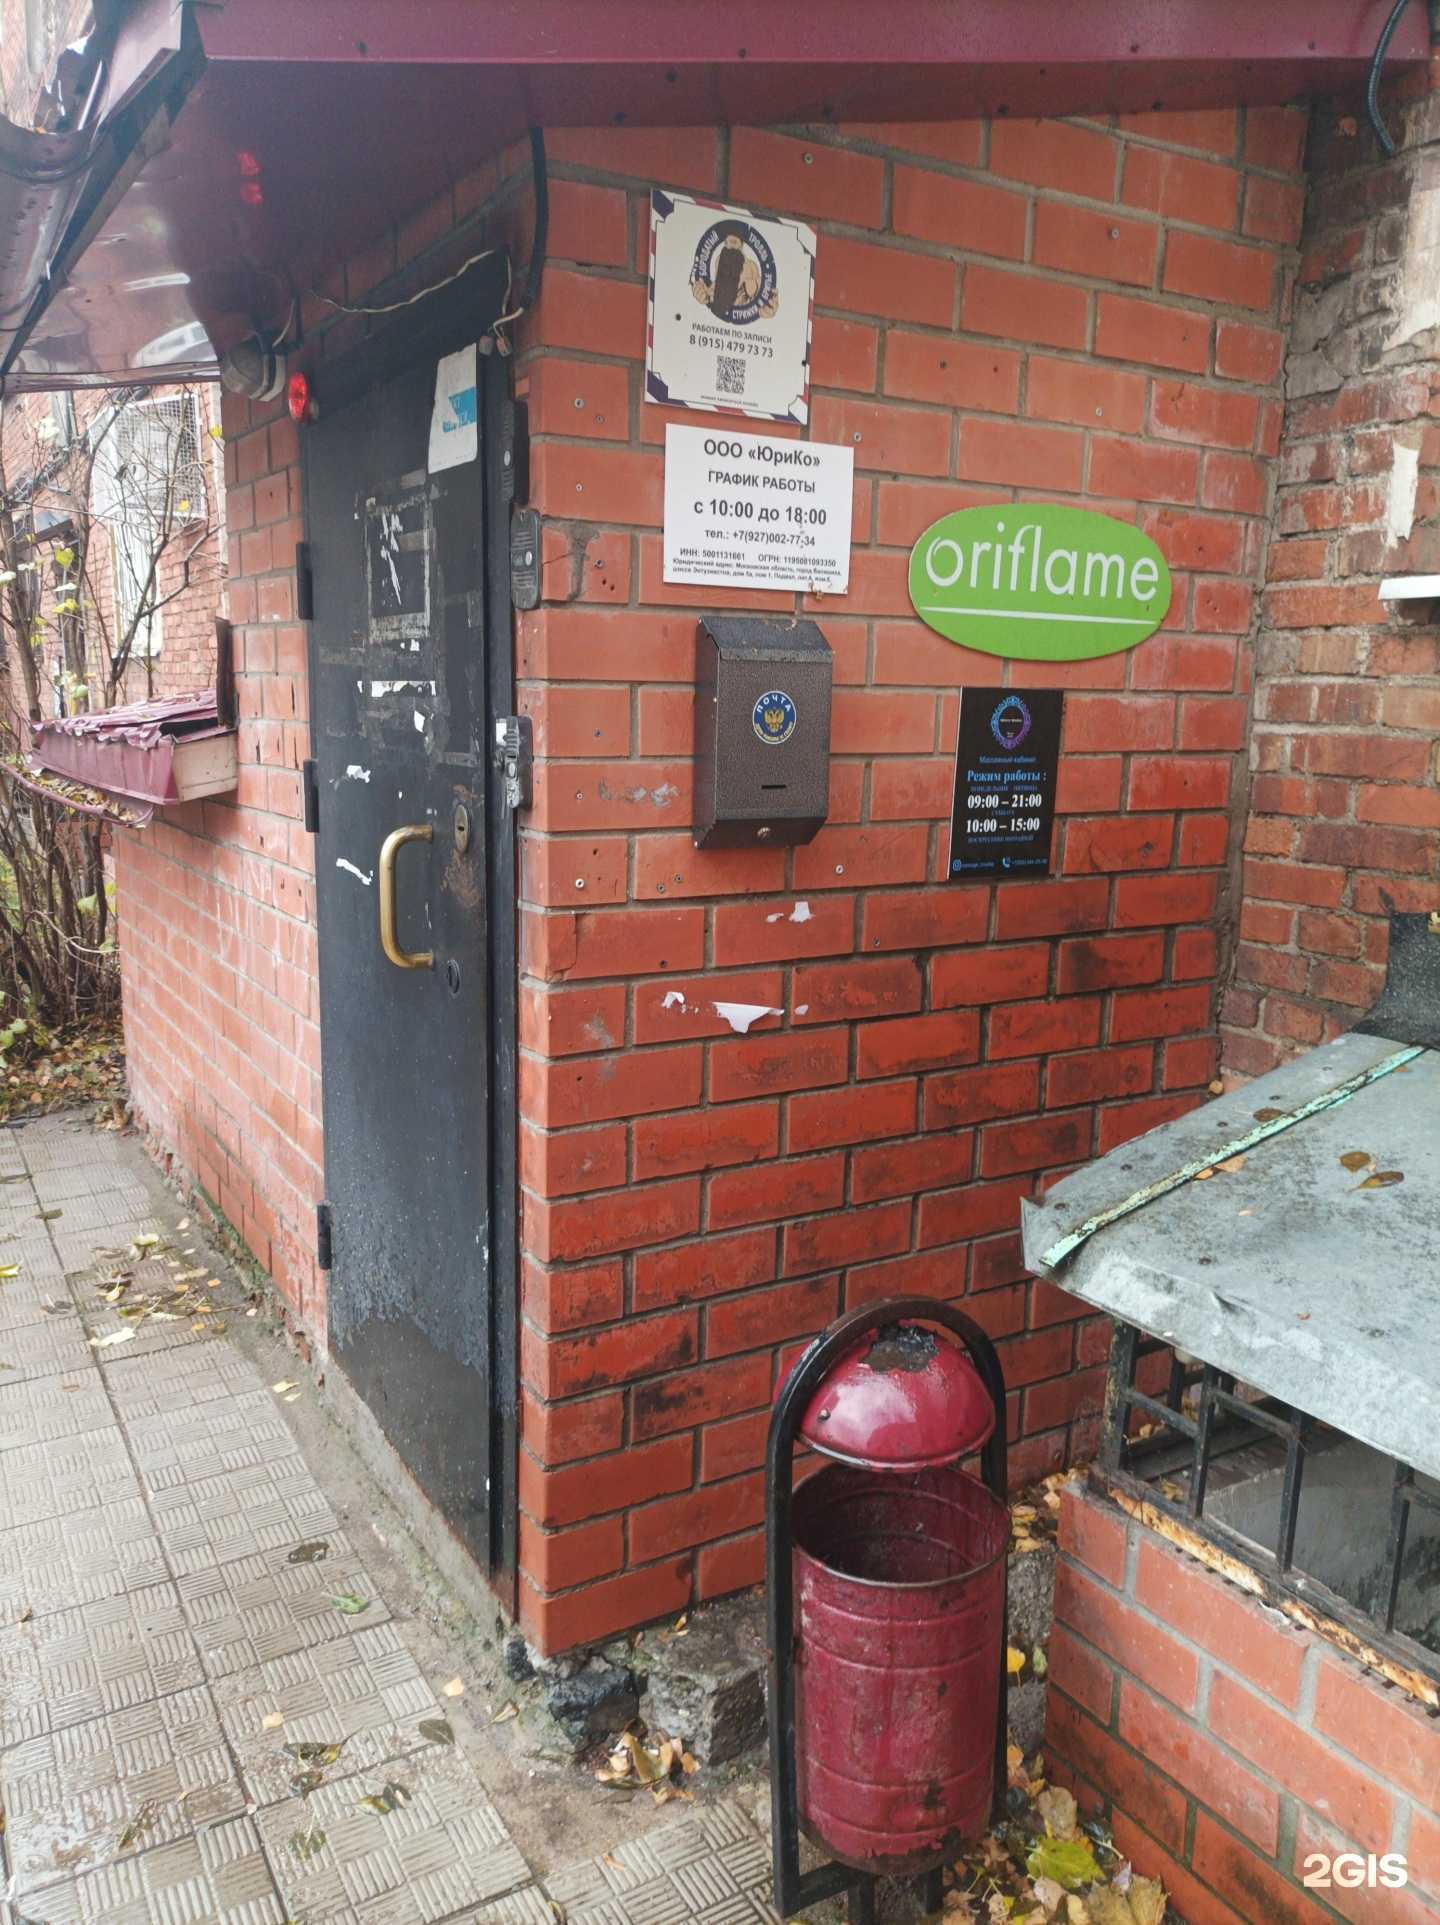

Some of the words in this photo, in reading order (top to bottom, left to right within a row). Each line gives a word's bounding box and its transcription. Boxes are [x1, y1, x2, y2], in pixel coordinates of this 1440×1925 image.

[692, 322, 731, 337] РАБОТАЕМ
[732, 329, 743, 338] ПО
[743, 331, 773, 345] ЗАПИСИ
[689, 334, 696, 345] 8
[698, 335, 724, 351] (915)
[726, 341, 745, 353] 479
[747, 343, 760, 356] 73
[761, 346, 774, 358] 73
[704, 439, 743, 459] ООО
[748, 445, 821, 467] «ЮриКо»
[708, 470, 760, 488] ГРАФИК
[762, 476, 816, 494] РАБОТЫ
[694, 501, 704, 515] с
[710, 499, 754, 519] 10:00
[757, 507, 780, 523] до
[785, 505, 827, 526] 18:00
[733, 531, 816, 548] +7(927)002-77-34
[680, 547, 701, 558] ИНН:
[756, 694, 792, 713] ПОЧТА
[967, 769, 1001, 783] Режим
[1003, 769, 1041, 785] работы
[967, 794, 999, 809] 09:00
[1011, 793, 1042, 808] 21:00
[966, 818, 998, 833] 10:00
[1010, 817, 1040, 832] 15:00
